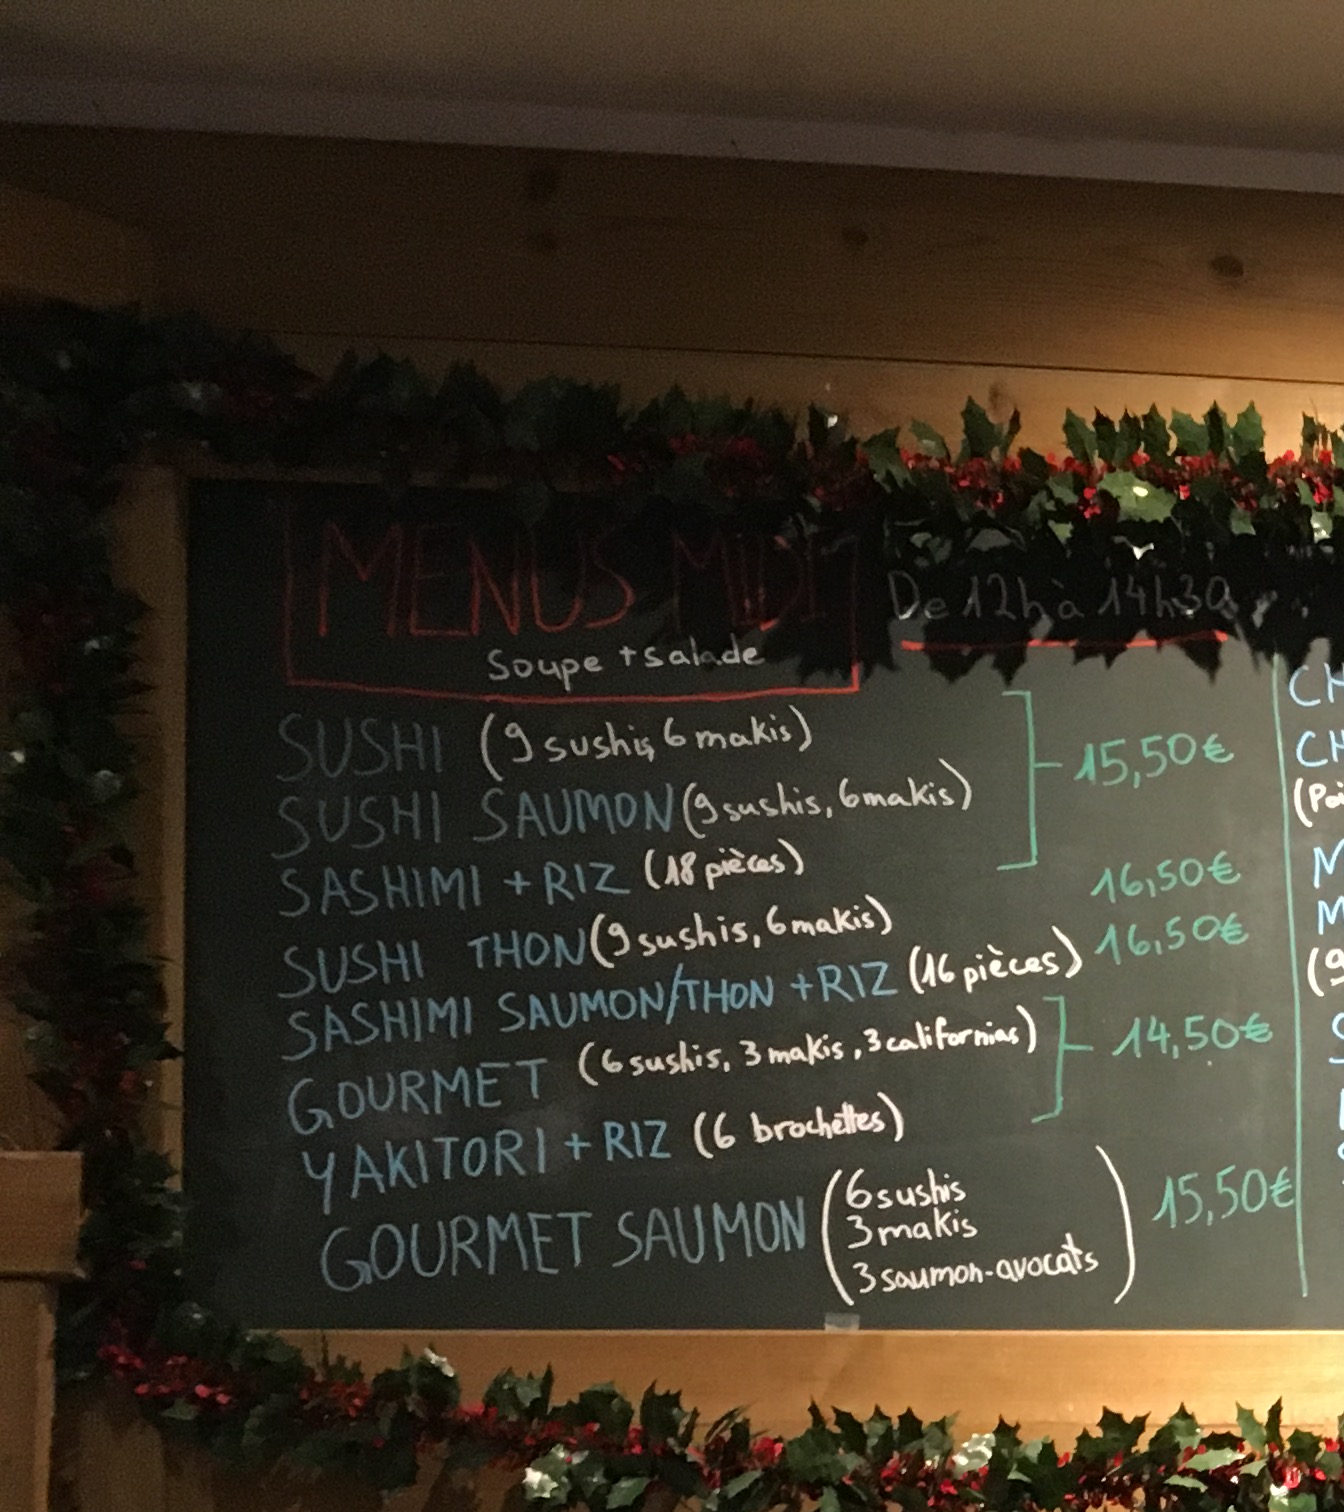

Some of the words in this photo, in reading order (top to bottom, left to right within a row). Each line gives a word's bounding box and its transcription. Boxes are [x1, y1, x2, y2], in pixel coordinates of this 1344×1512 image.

[316, 518, 637, 637] MENUS
[888, 570, 949, 620] De
[486, 649, 604, 692] Soupe
[276, 713, 443, 782] SUSHI
[1073, 732, 1235, 788] 15,50€
[271, 791, 441, 859] SUSHI
[473, 783, 674, 842] SAUMON
[278, 864, 482, 917] SASHIMI
[544, 860, 630, 905] RIZ
[1090, 850, 1241, 903] 16,50€
[276, 940, 425, 999] SUSHI
[467, 927, 588, 969] THON
[1094, 913, 1249, 965] 16,50€
[281, 997, 473, 1062] SASHIMI
[1113, 1013, 1273, 1058] 14,50€
[287, 1057, 549, 1136] GOURMET
[302, 1127, 547, 1215] YAKITORI
[604, 1119, 671, 1161] RIZ
[1153, 1165, 1294, 1229] 15,50€
[321, 1211, 593, 1292] GOURMET
[612, 1196, 807, 1268] SAUMON
